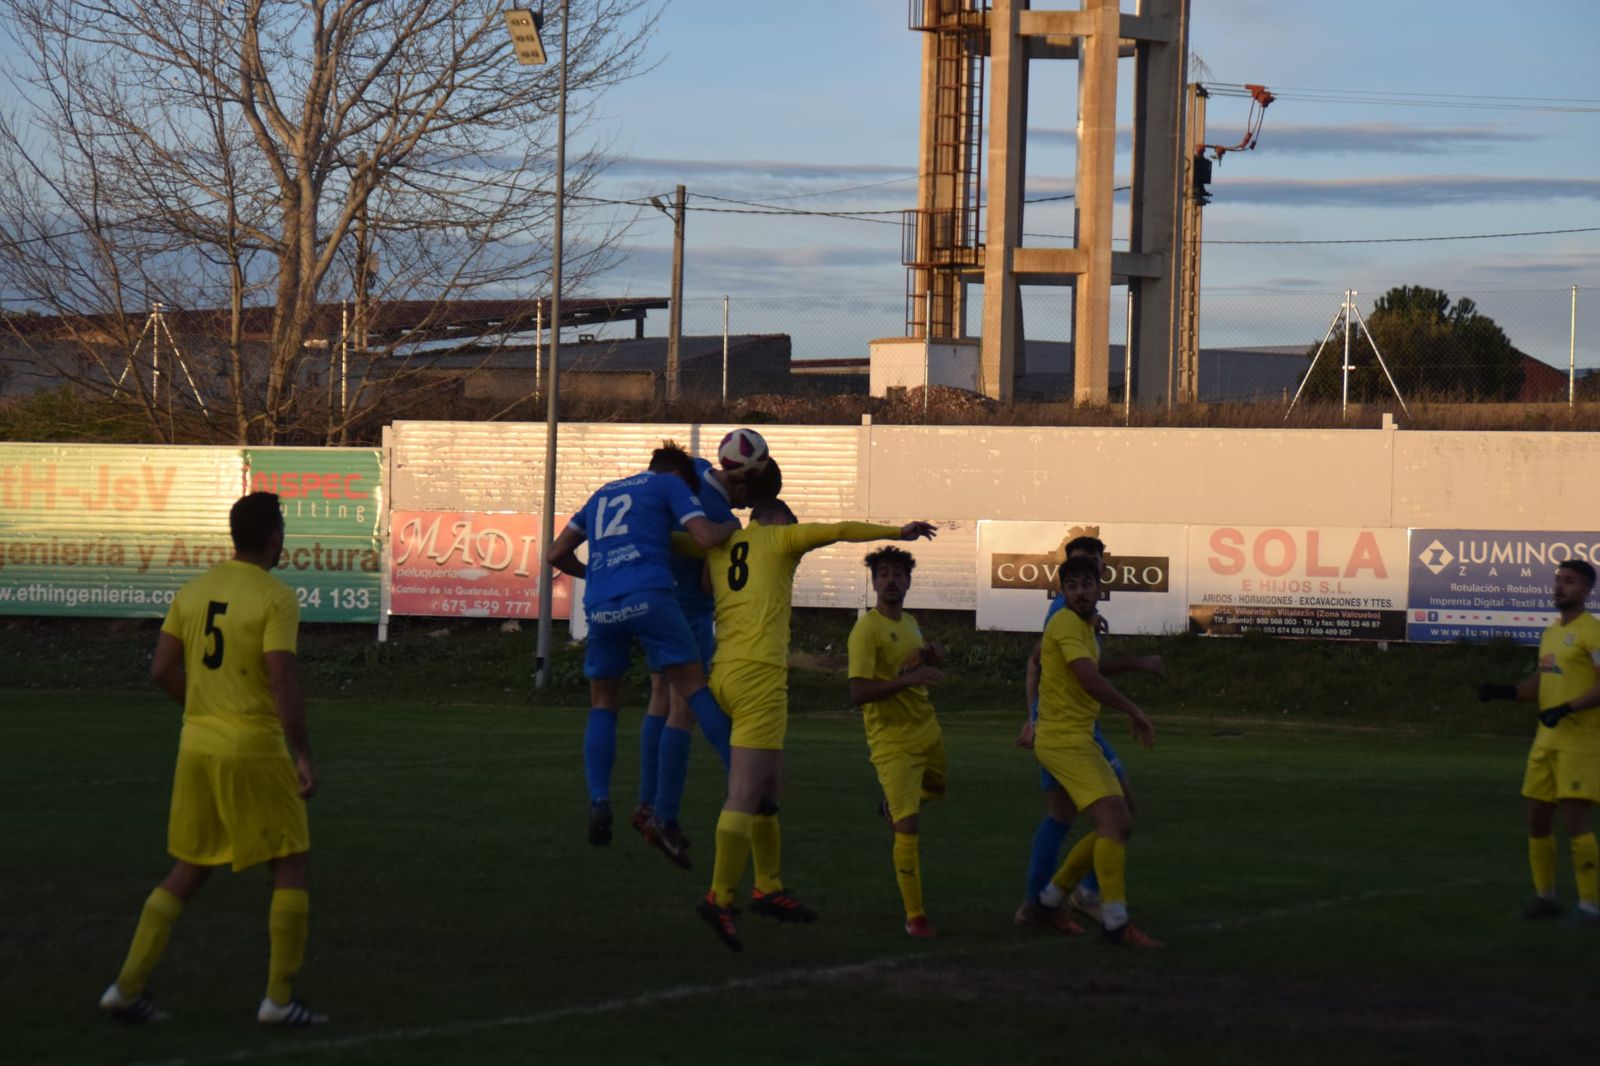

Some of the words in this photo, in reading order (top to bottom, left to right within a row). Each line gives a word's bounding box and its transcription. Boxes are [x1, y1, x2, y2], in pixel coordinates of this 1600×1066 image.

[279, 499, 366, 523] ulting
[595, 494, 632, 540] 12
[397, 515, 562, 578] MADI
[1208, 527, 1388, 579] SOLA
[137, 544, 157, 573] y
[728, 541, 749, 591] 8
[997, 563, 1163, 585] COVORO
[1459, 566, 1561, 577] ZAM
[429, 585, 441, 594] de
[1242, 579, 1252, 592] E
[1260, 579, 1312, 593] HIJOS
[1319, 580, 1352, 594] S.L.
[1451, 583, 1500, 594] Rotulación
[1507, 584, 1542, 594] Rotulos
[294, 587, 321, 607] 24
[329, 588, 370, 609] 133
[441, 600, 467, 612] 675
[474, 601, 500, 613] 529
[505, 601, 532, 615] 777
[1202, 593, 1233, 603] ARIDOS
[1238, 594, 1293, 605] HORMIGONES
[1299, 596, 1361, 607] EXCAVACIONES
[1361, 598, 1369, 607] Y
[1371, 598, 1394, 608] TTES.
[1430, 597, 1472, 608] Imprenta
[1474, 597, 1504, 608] Digital
[1511, 599, 1536, 608] Textil
[202, 600, 228, 670] 5
[1430, 627, 1542, 640] www.luminososz
